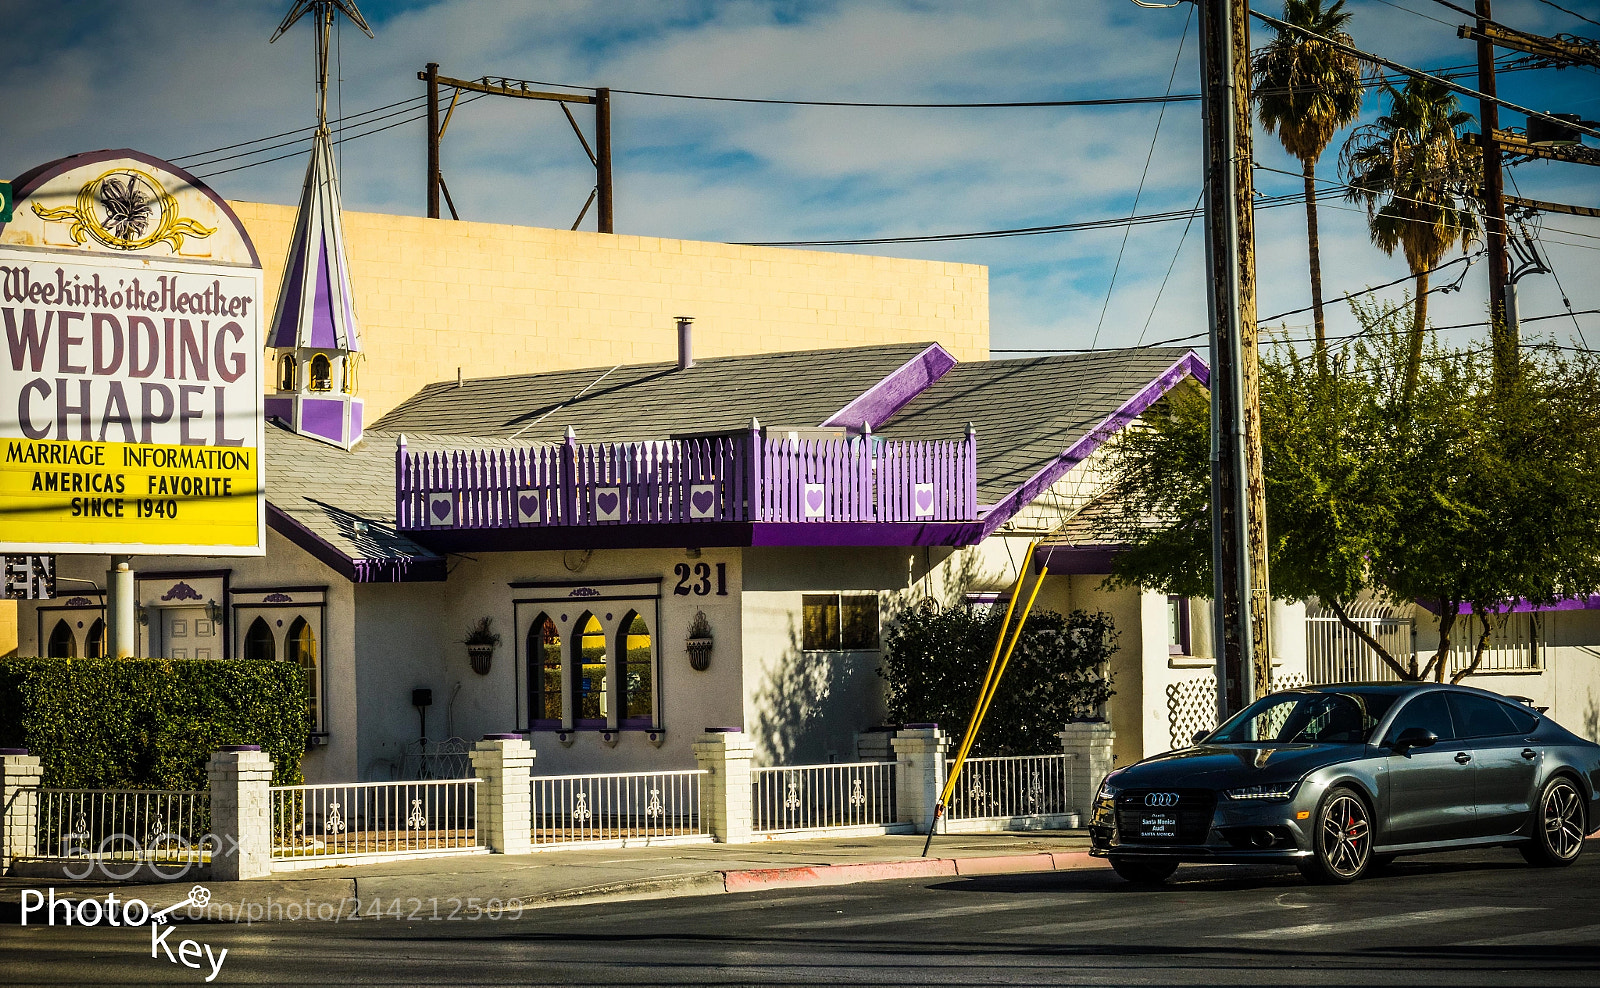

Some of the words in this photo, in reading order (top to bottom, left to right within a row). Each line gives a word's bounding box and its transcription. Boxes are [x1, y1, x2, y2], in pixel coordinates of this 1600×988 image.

[0, 265, 56, 304] Wee
[156, 275, 253, 318] Heather
[1, 306, 247, 383] WEDDING
[17, 377, 245, 448] CHAPEL
[6, 441, 105, 466] MARRIAGE
[123, 447, 250, 471] INFORMATION
[32, 471, 125, 494] AMERICAS
[148, 475, 232, 497] FAVORITE
[72, 497, 124, 518] SINCE
[136, 498, 178, 519] 1940
[673, 562, 728, 596] 231
